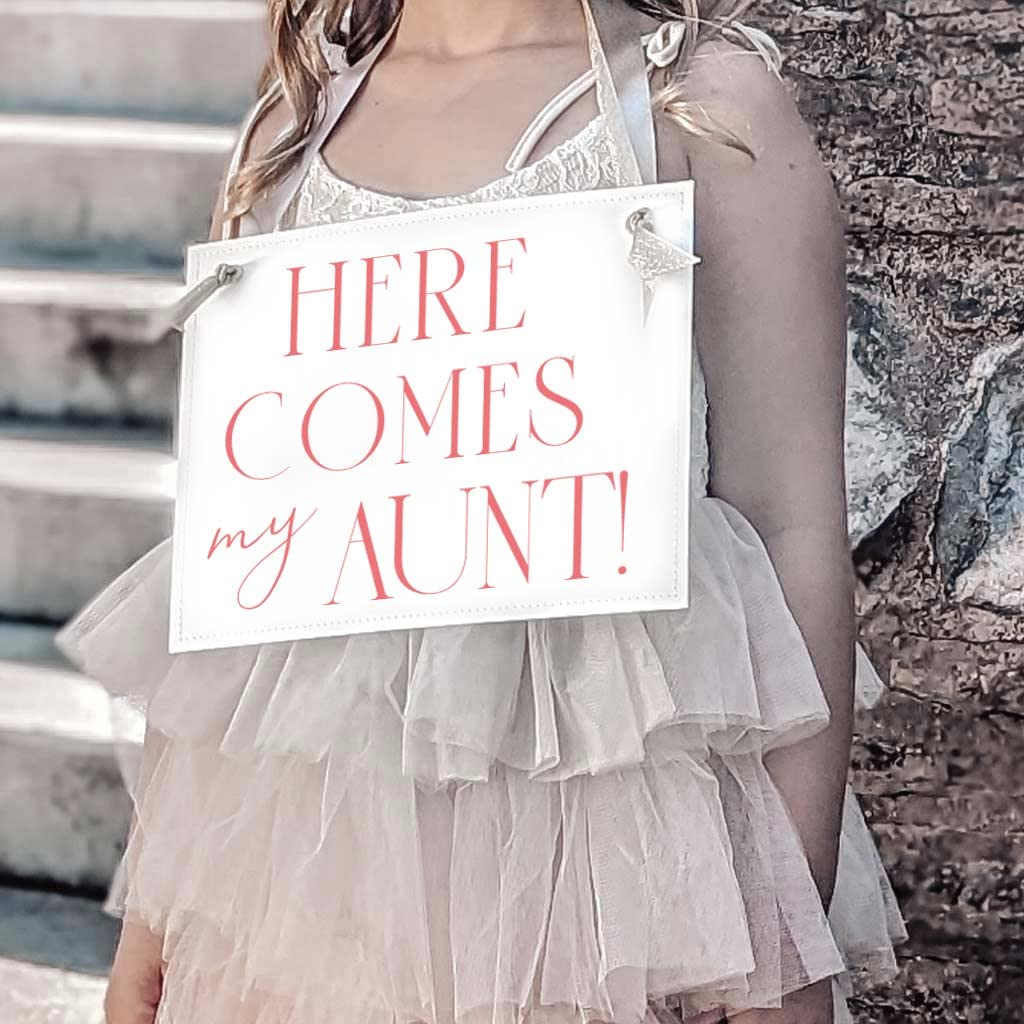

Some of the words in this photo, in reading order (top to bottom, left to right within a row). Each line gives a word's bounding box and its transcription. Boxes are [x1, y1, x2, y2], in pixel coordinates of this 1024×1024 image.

[283, 236, 528, 357] HERE
[224, 355, 584, 480] COMES
[206, 506, 318, 611] my
[322, 469, 629, 606] AUNT!
